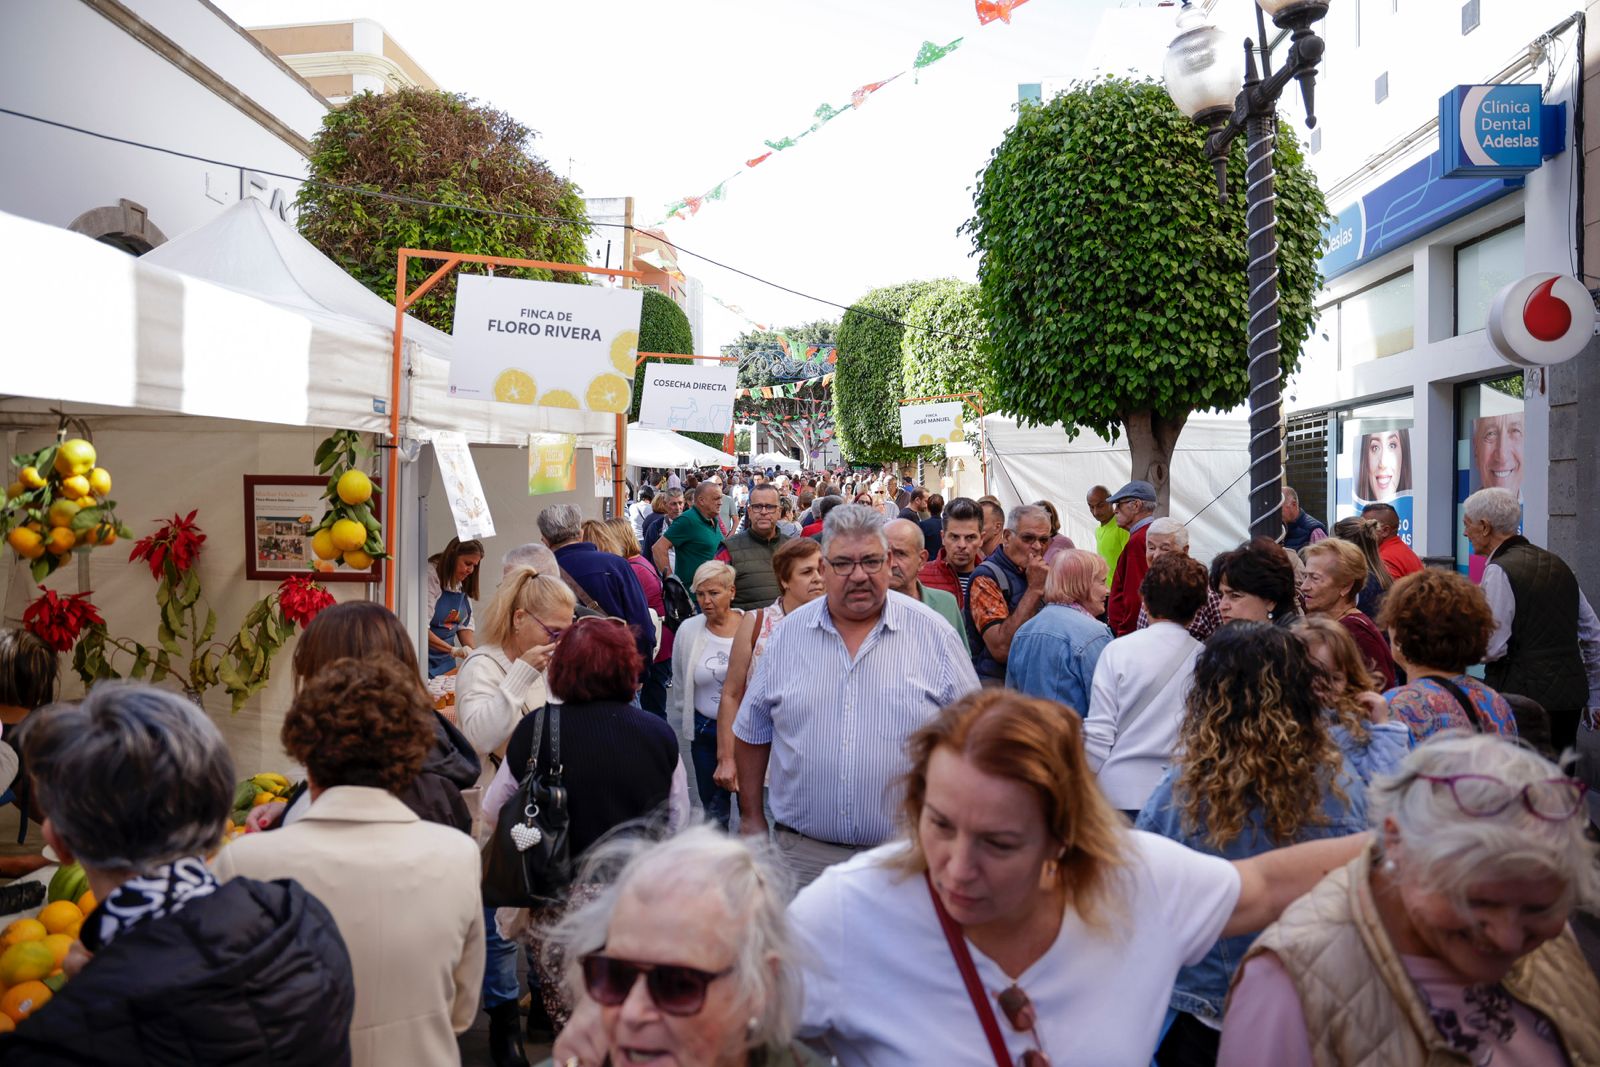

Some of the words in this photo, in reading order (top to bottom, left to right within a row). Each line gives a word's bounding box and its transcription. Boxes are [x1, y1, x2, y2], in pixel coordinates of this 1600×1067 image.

[1481, 100, 1530, 114] Clínica
[1481, 116, 1531, 131] Dental
[1482, 133, 1540, 148] Adeslas
[520, 308, 555, 320] FINCA
[557, 311, 573, 322] DE
[487, 318, 541, 336] FLORO
[544, 324, 602, 342] RIVERA
[653, 378, 692, 390] COSECHA
[692, 381, 727, 392] DIRECTA
